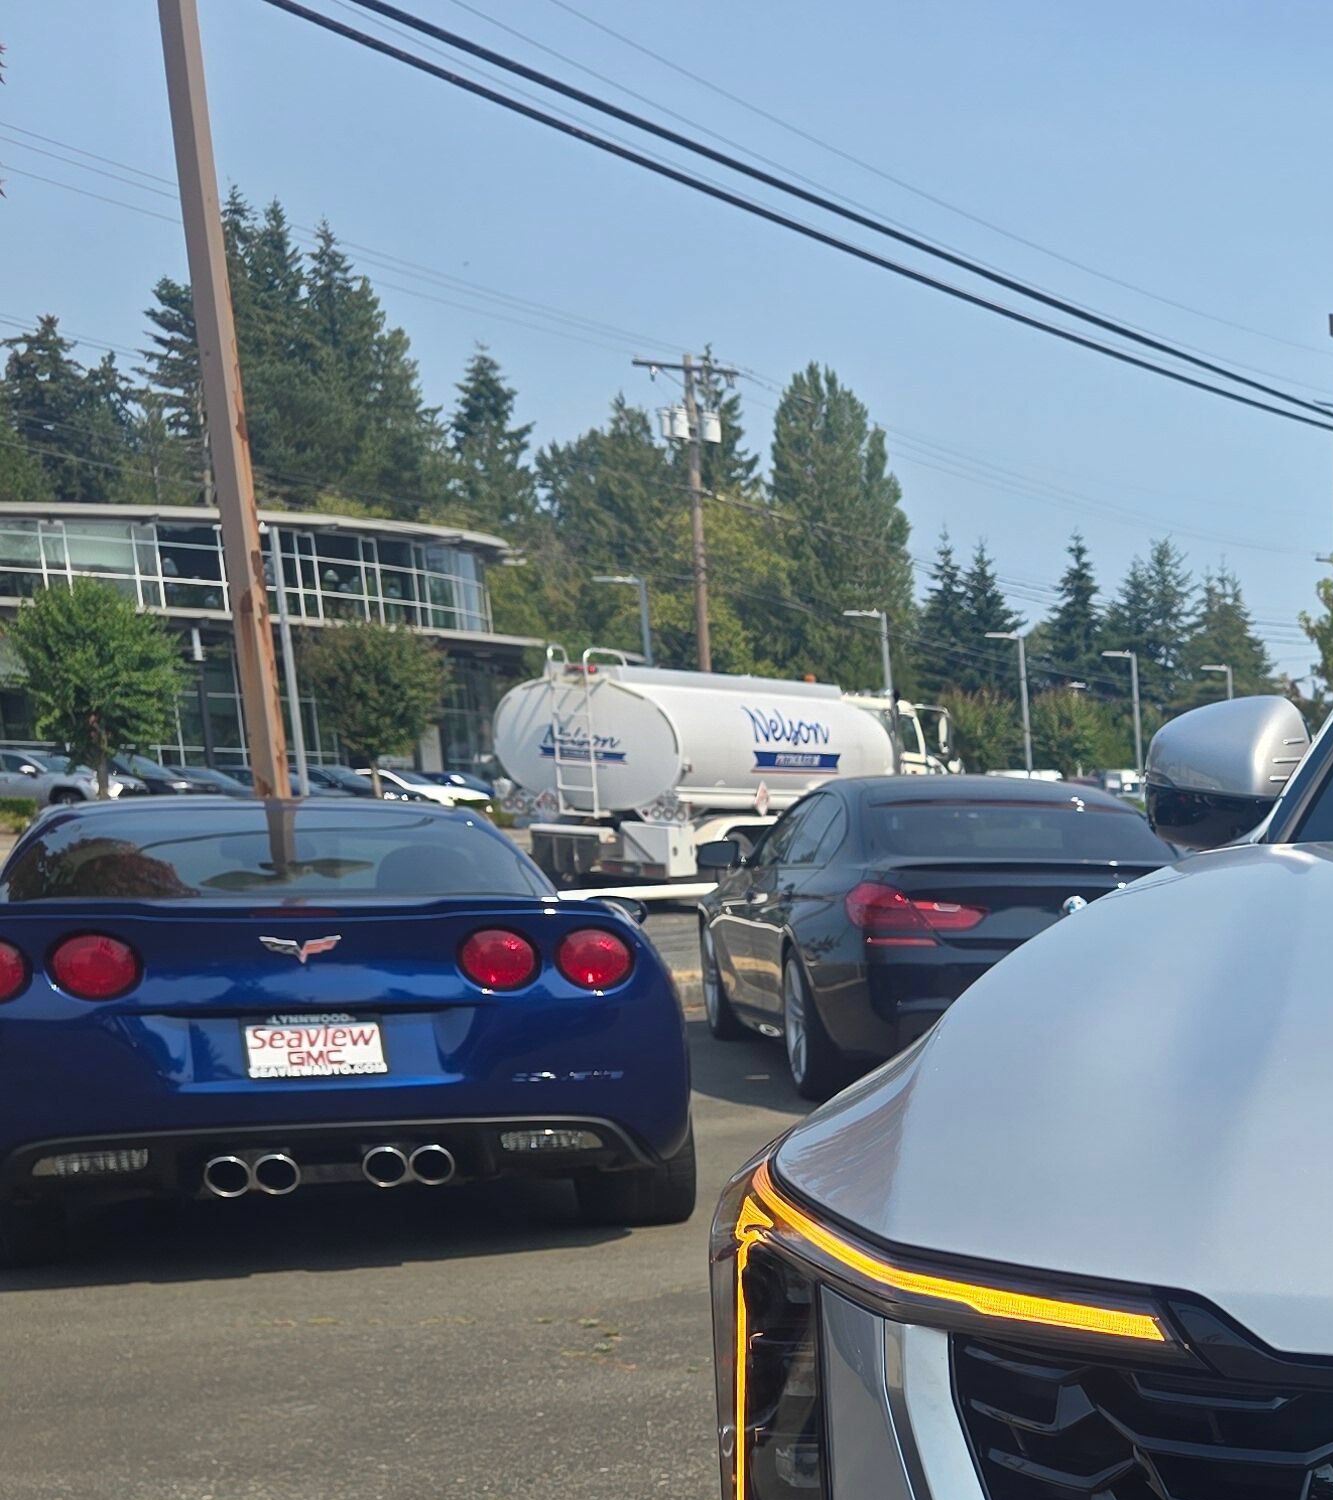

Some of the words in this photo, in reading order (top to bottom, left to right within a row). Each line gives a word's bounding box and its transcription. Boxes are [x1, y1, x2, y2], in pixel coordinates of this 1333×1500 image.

[741, 704, 829, 746] Nelson
[248, 1024, 375, 1050] Seaview
[287, 1049, 345, 1066] GMC
